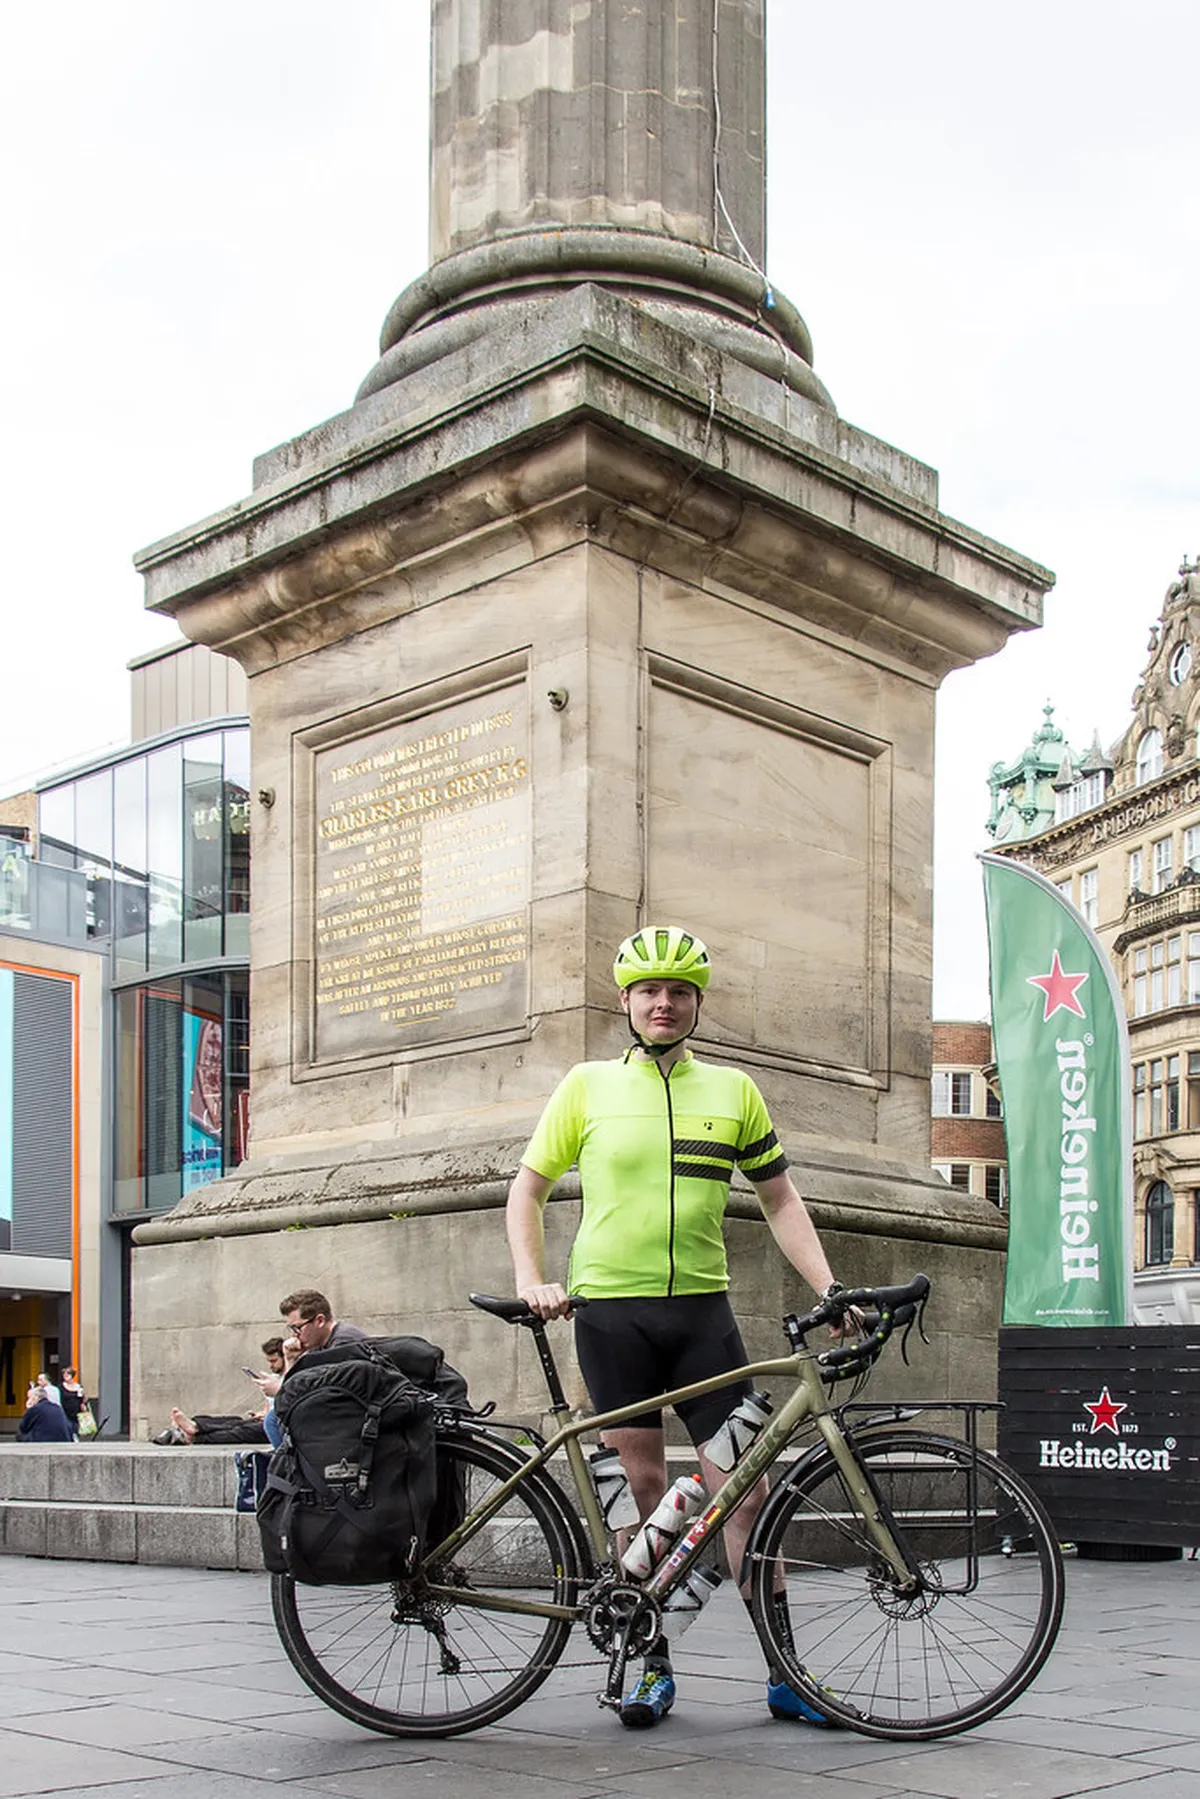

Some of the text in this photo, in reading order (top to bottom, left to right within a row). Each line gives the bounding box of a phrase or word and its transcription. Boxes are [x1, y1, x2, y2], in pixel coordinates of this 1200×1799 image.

[394, 784, 441, 818] EARL
[408, 1001, 434, 1016] YEAR
[717, 1423, 783, 1504] TREK
[1039, 1440, 1171, 1471] Heineken
